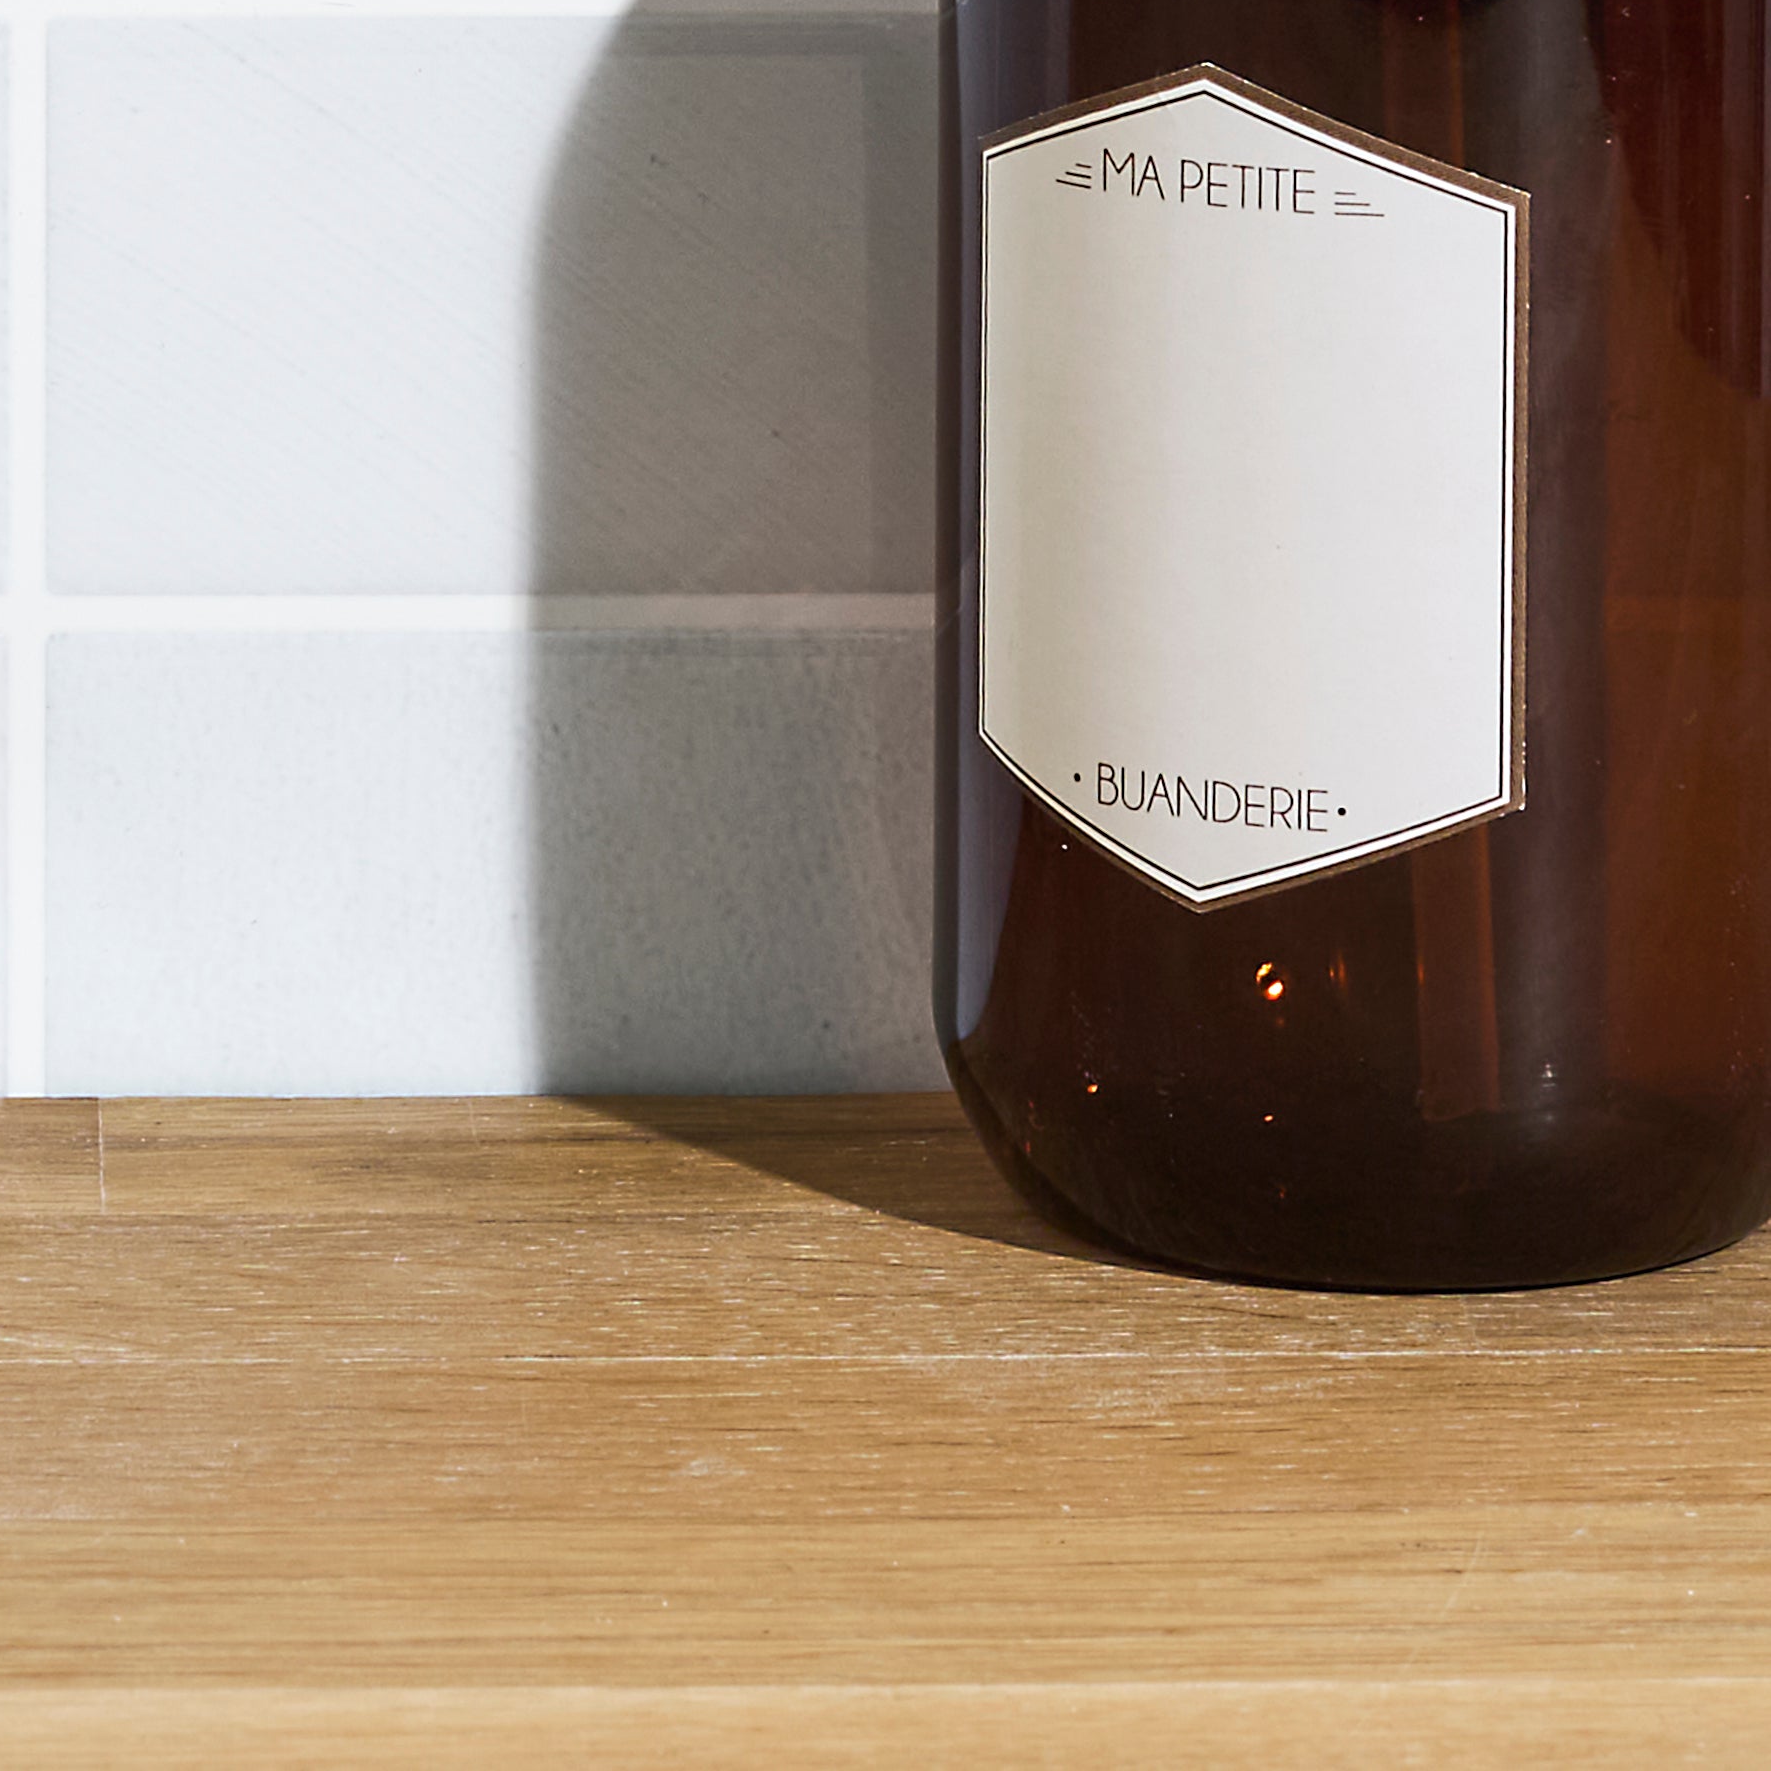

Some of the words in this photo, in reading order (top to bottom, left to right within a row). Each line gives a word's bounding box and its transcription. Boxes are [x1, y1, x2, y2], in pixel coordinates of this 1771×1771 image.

[1102, 147, 1165, 201] MA
[1180, 158, 1316, 214] PETITE
[1097, 762, 1329, 832] BUANDERIE
